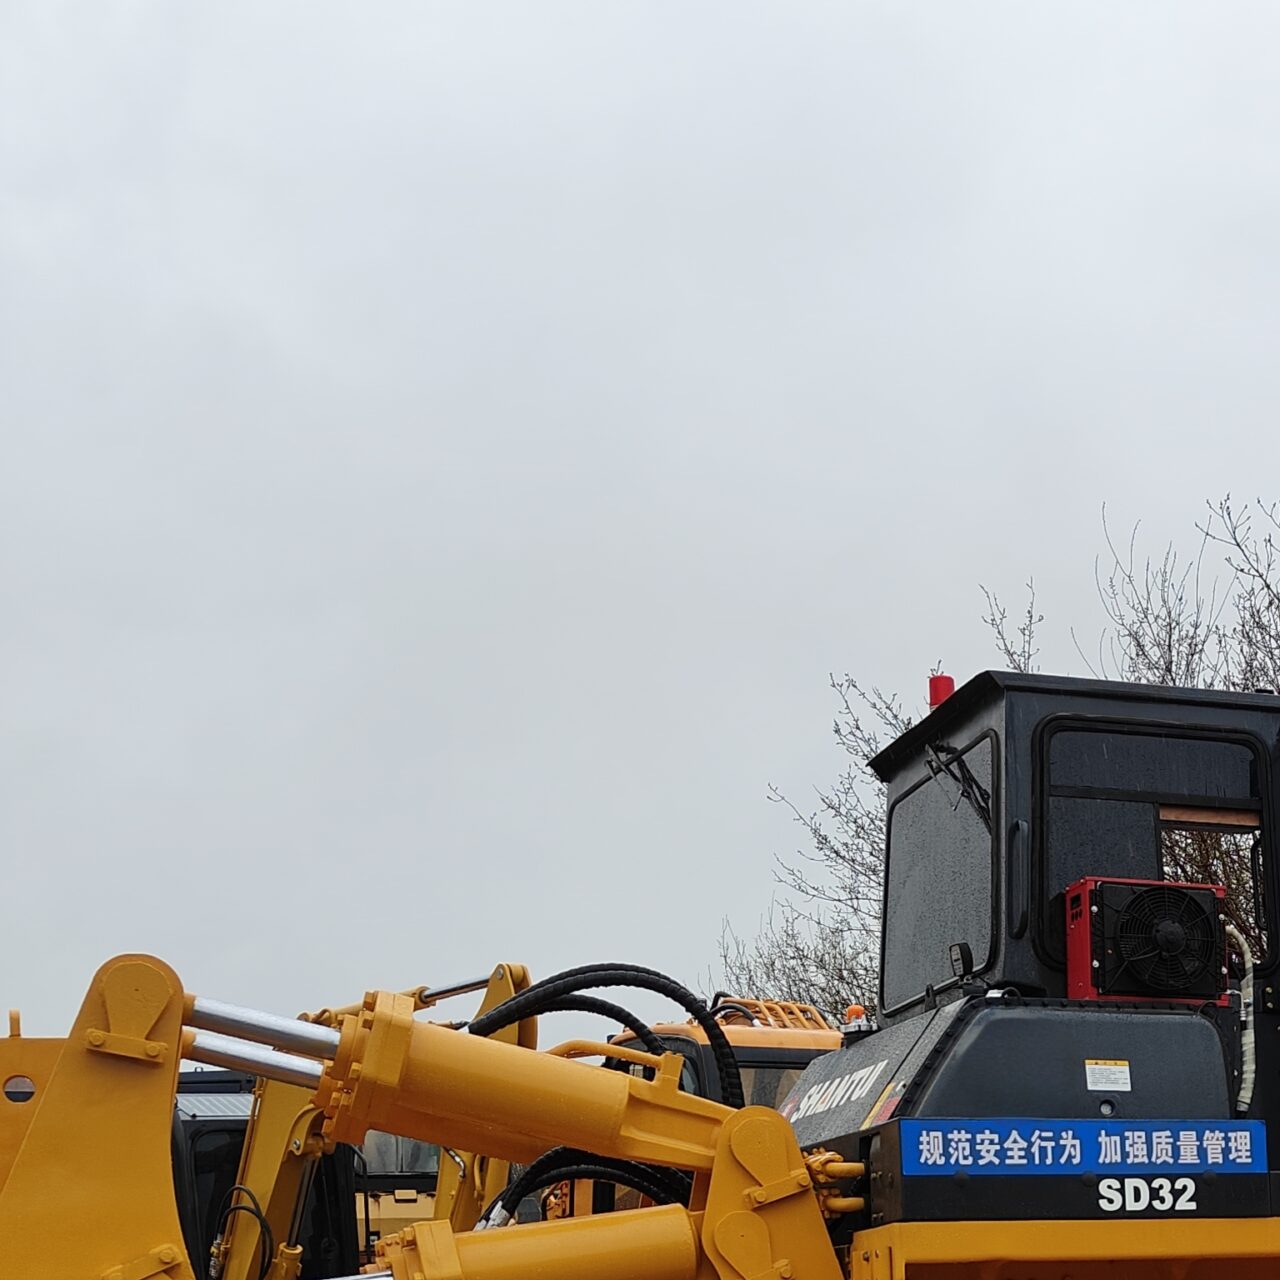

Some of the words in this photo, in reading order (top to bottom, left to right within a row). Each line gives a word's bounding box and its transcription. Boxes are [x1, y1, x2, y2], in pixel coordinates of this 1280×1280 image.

[790, 1059, 888, 1123] SHANTUI
[919, 1130, 1081, 1165] 规范安全行为
[1098, 1130, 1252, 1164] 加强质量管理
[1098, 1178, 1197, 1211] SD32
